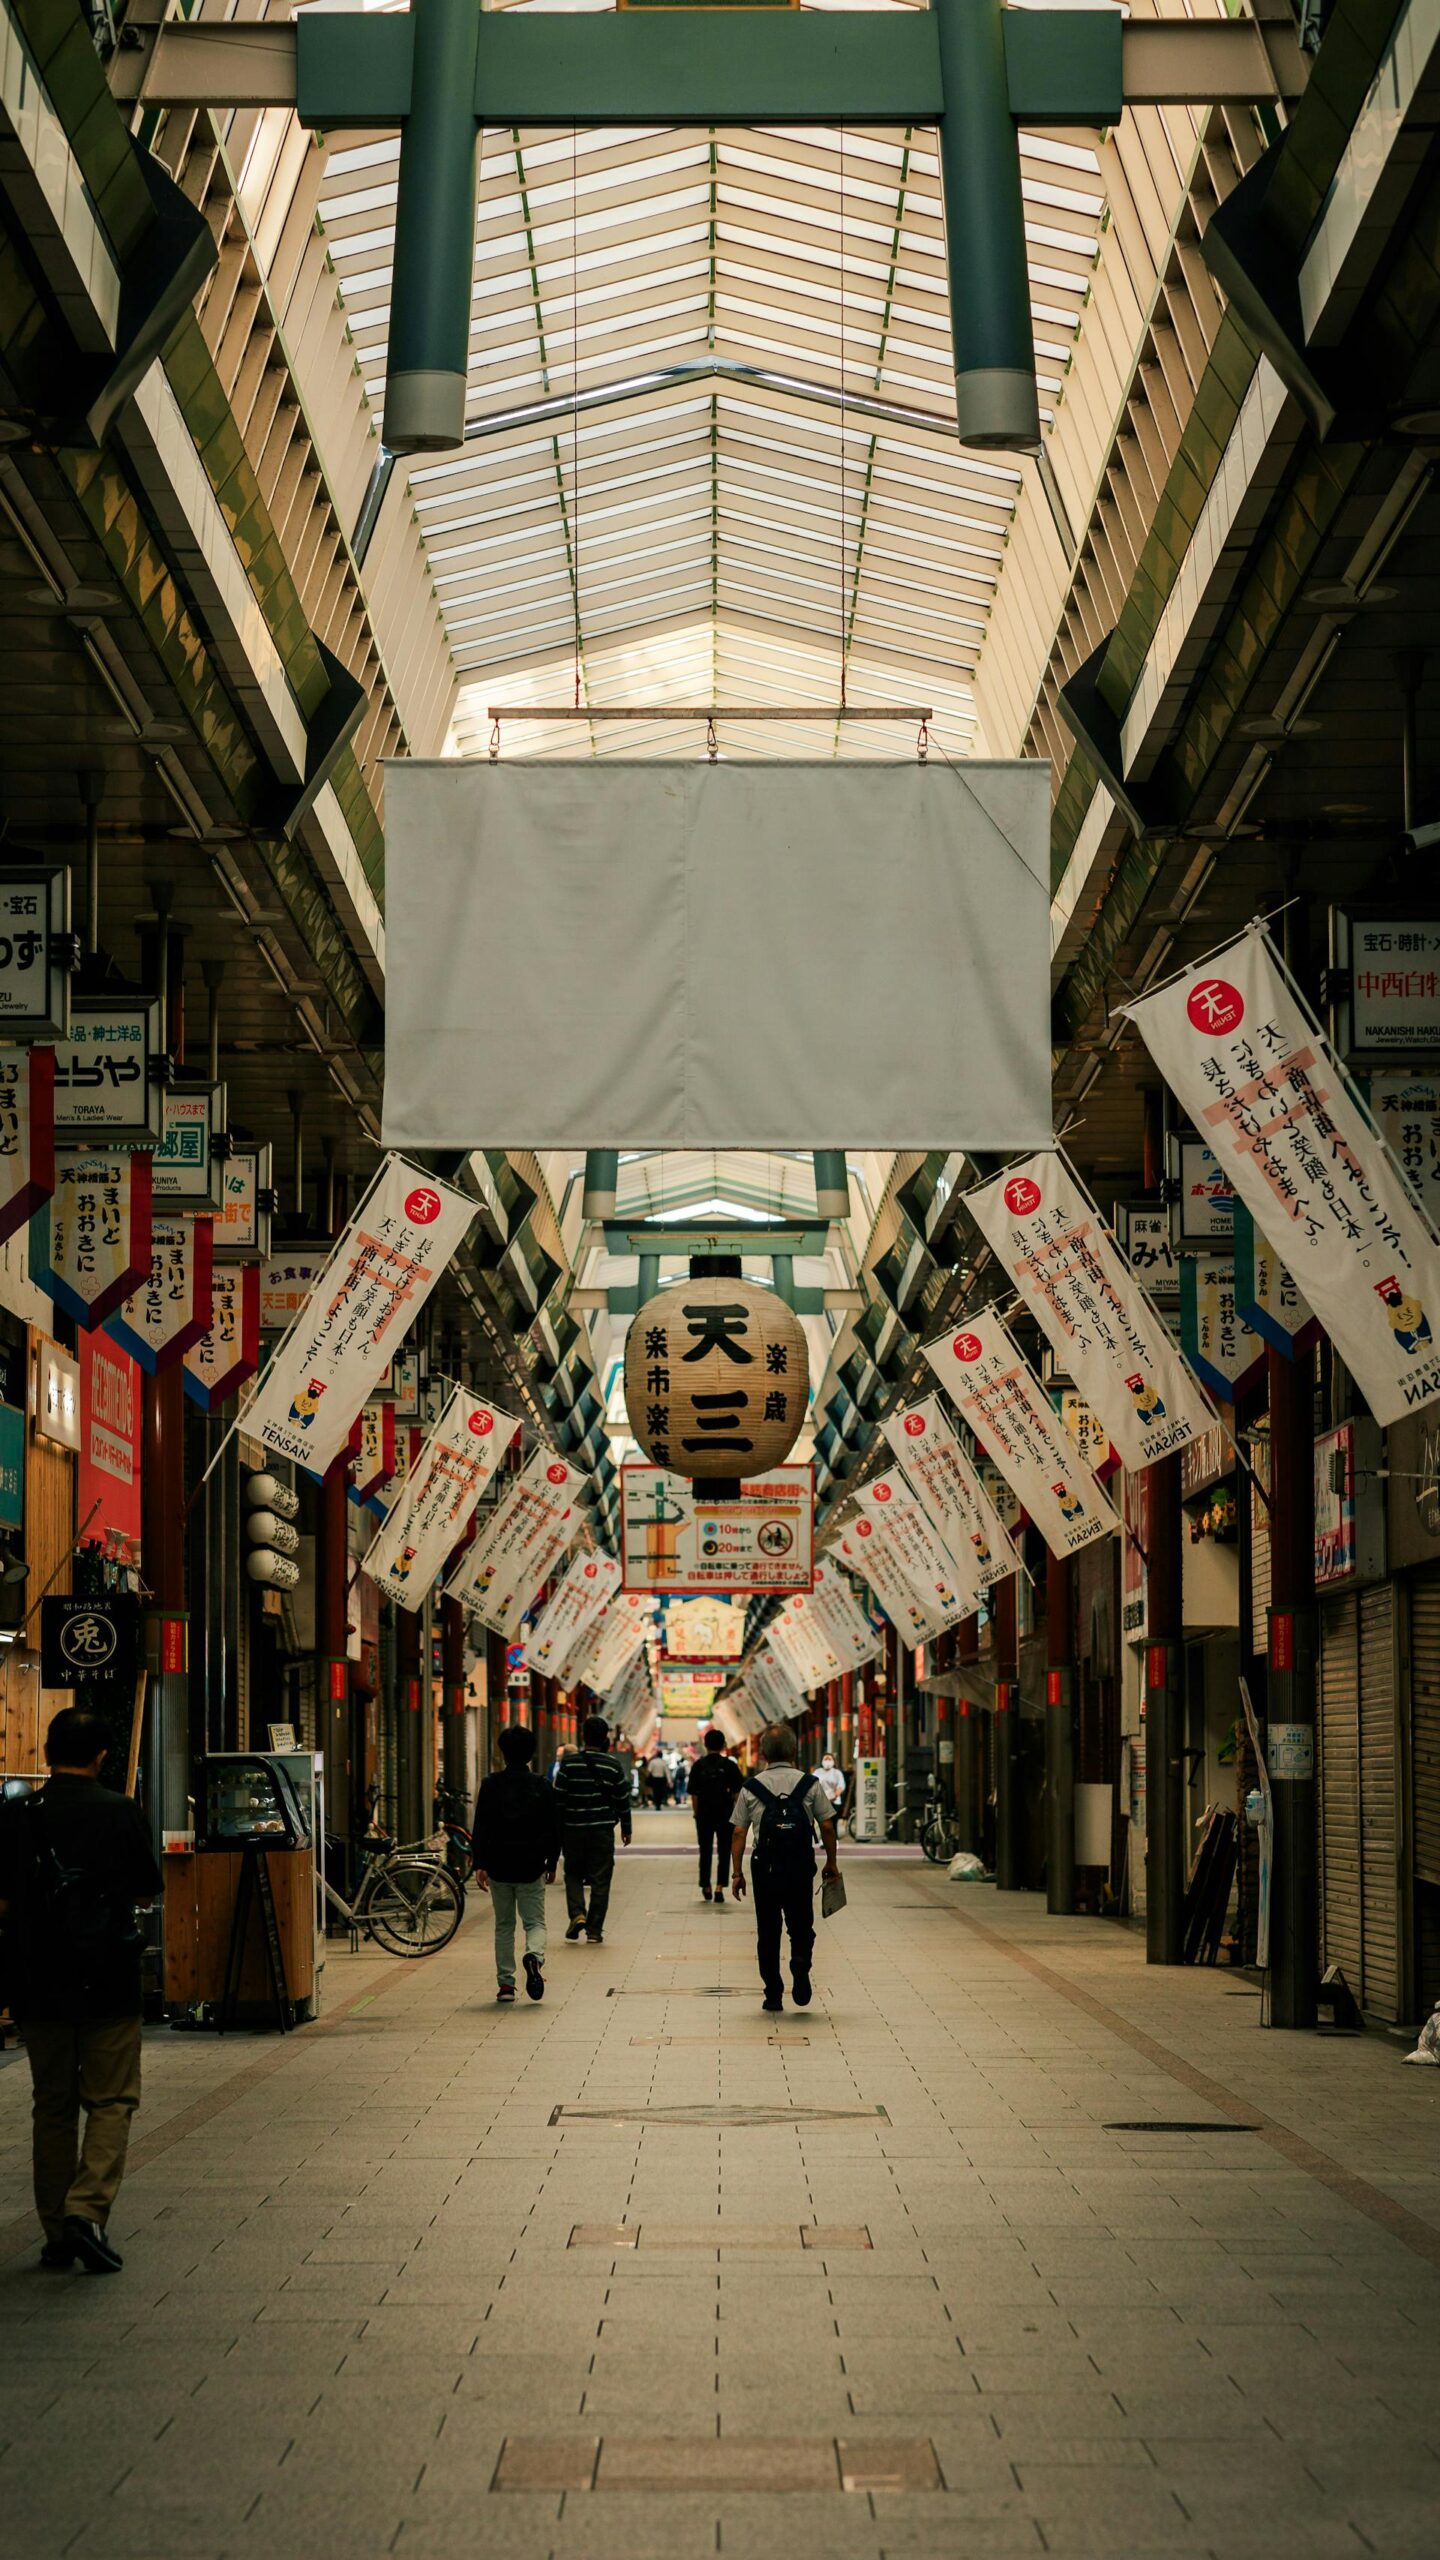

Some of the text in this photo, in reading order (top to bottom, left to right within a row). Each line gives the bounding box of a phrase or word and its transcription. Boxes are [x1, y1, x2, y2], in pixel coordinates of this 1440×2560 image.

[73, 1106, 105, 1115] TORAYA
[54, 1222, 65, 1262] てんさん
[77, 1194, 96, 1273] おおきに
[102, 1187, 121, 1246] まいど
[166, 1248, 185, 1301] まいど
[1220, 1293, 1235, 1358] おおきに
[644, 1326, 674, 1468] 楽市楽座
[681, 1304, 758, 1453] 天三
[260, 1425, 311, 1462] TENSAN
[61, 1668, 117, 1682] 中華そば
